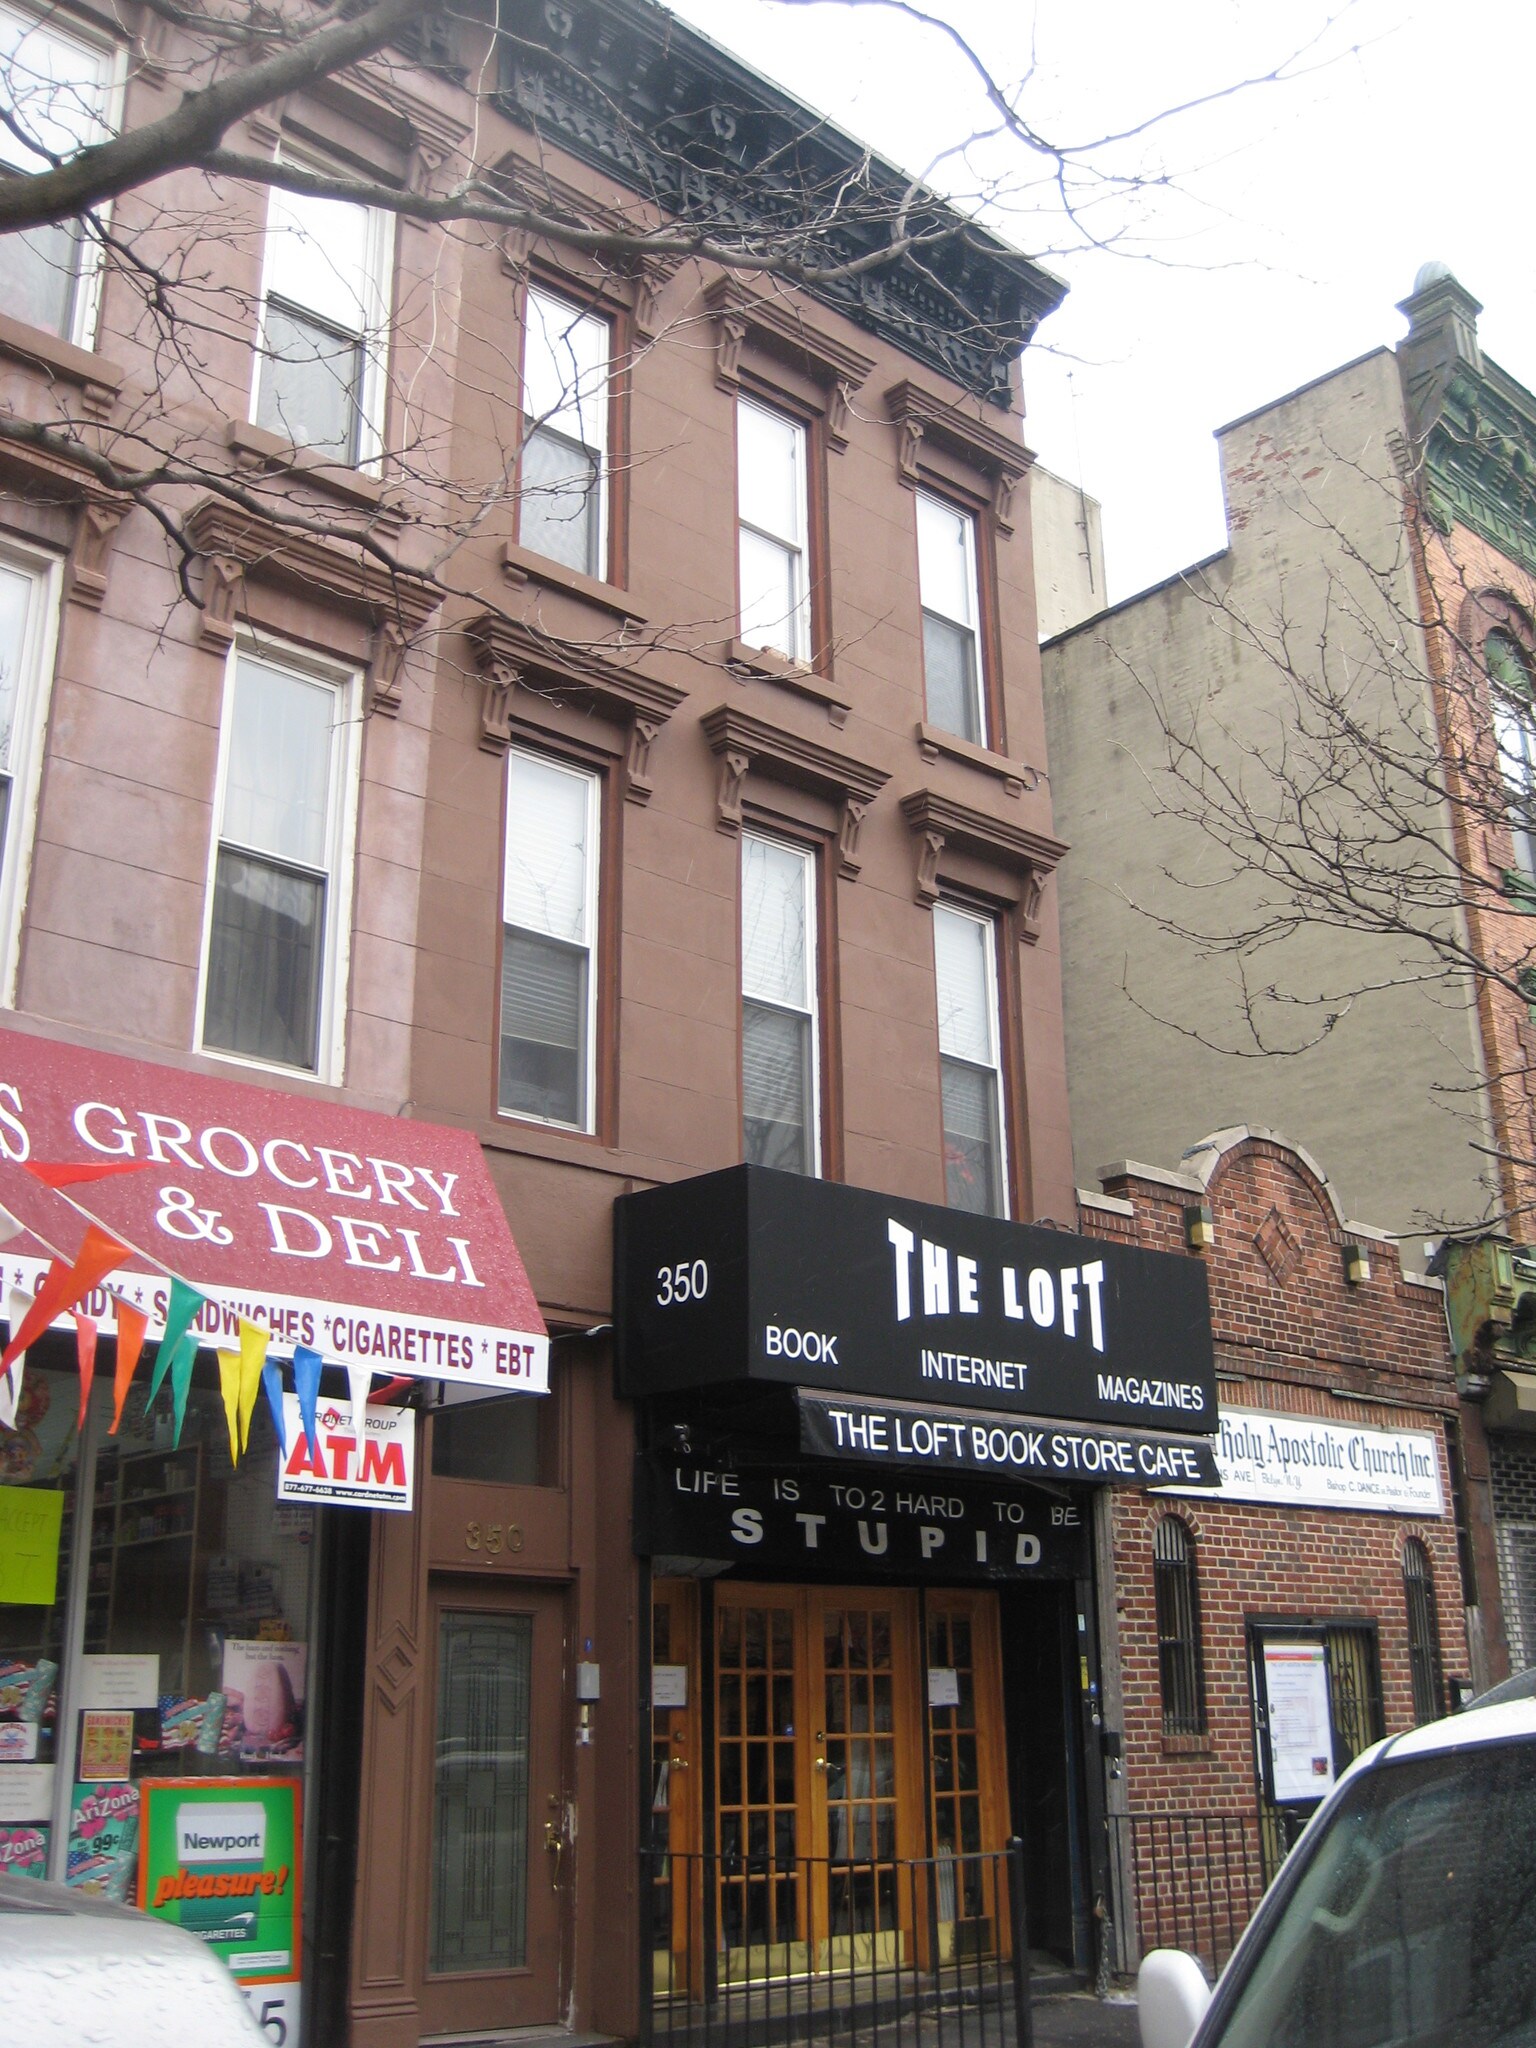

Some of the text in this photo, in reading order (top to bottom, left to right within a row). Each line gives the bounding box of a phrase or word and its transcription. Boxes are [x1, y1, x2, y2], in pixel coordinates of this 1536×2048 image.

[73, 1101, 461, 1217] GROCERY
[155, 1186, 486, 1287] & DELI
[656, 1259, 708, 1306] 350
[888, 1217, 1105, 1353] THE LOFT
[332, 1316, 474, 1370] CIGARETTES
[496, 1341, 535, 1377] EBT
[766, 1325, 839, 1365] BOOK
[921, 1349, 1028, 1391] INTERNET
[1097, 1373, 1204, 1411] MAGAZINES
[364, 1418, 397, 1431] ROUP
[828, 1410, 1201, 1479] THE LOFT BOOK STORE CAFE
[285, 1431, 407, 1487] ATM
[1267, 1424, 1344, 1474] Apostolic
[1348, 1436, 1409, 1482] Church
[1408, 1443, 1435, 1478] Inc.
[675, 1468, 740, 1497] LIFE
[774, 1478, 800, 1501] IS
[829, 1484, 865, 1510] TO
[896, 1492, 964, 1518] HARD
[993, 1501, 1024, 1524] TO
[1051, 1506, 1081, 1526] BE
[465, 1521, 524, 1554] 350
[731, 1507, 1042, 1565] STUPID
[184, 1833, 260, 1851] Newport
[153, 1864, 289, 1908] pleasure!
